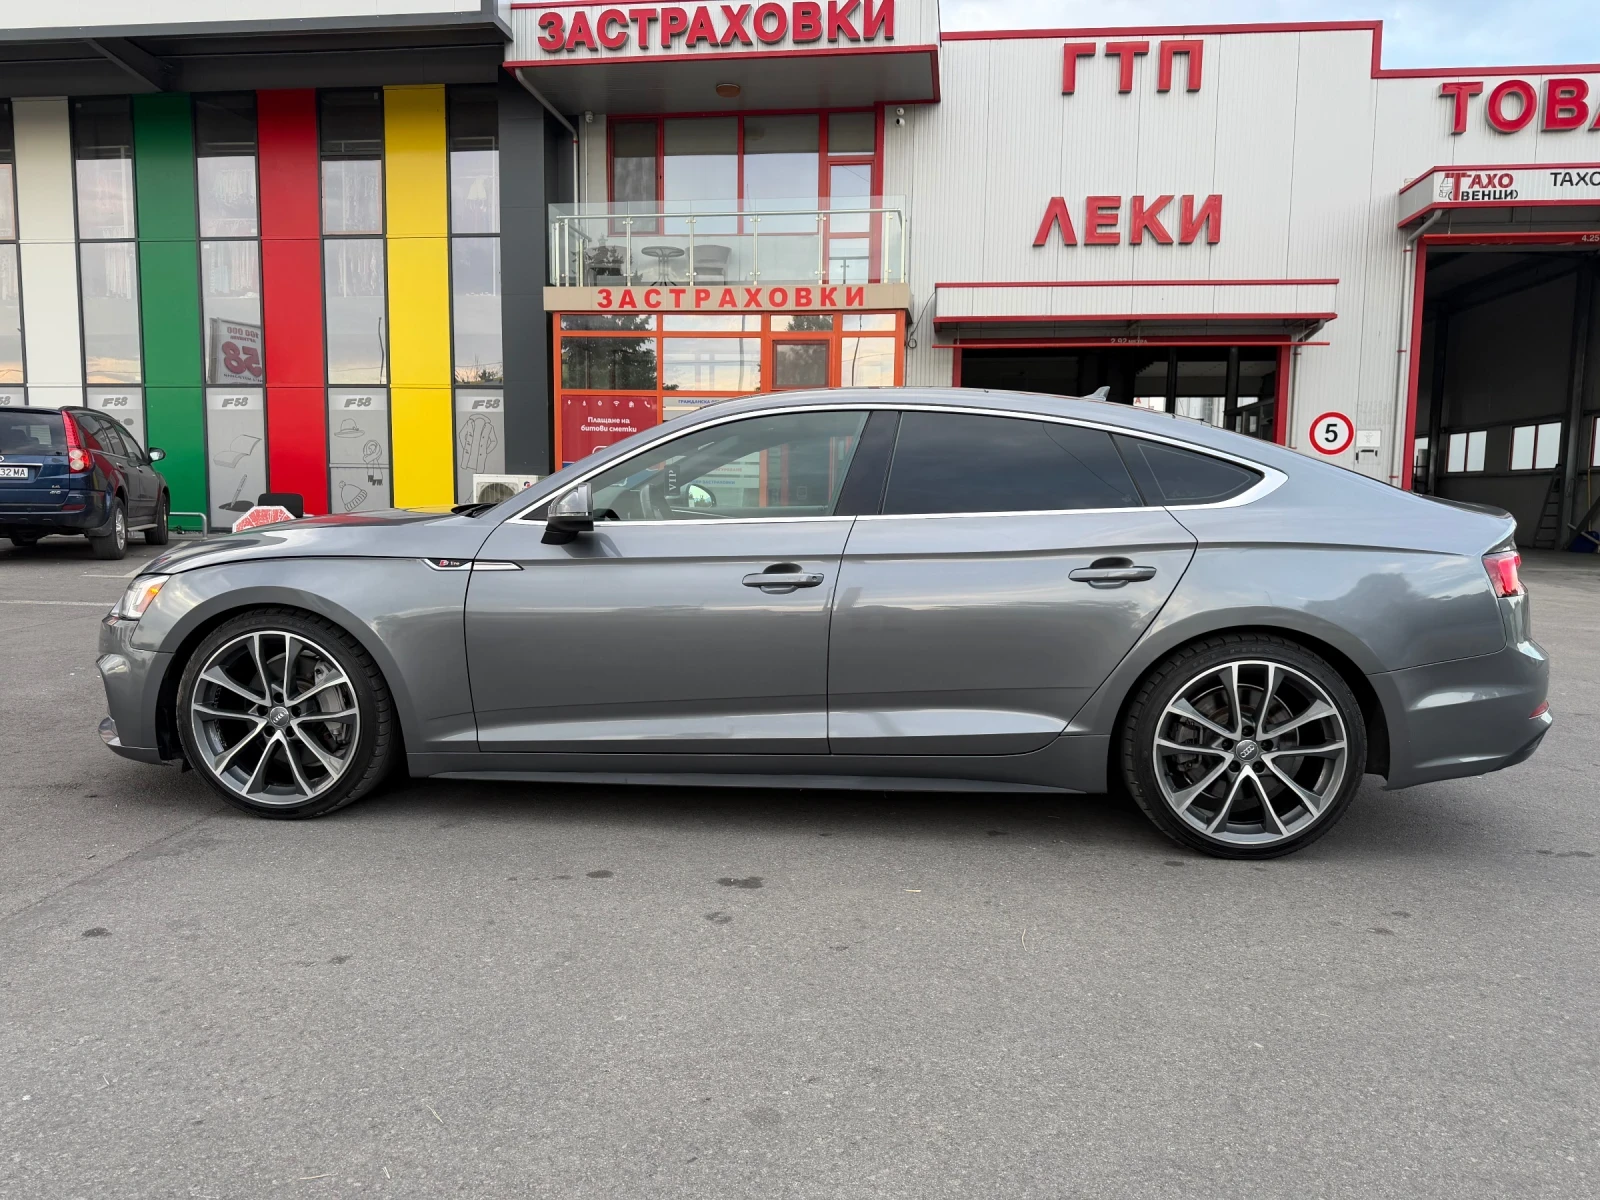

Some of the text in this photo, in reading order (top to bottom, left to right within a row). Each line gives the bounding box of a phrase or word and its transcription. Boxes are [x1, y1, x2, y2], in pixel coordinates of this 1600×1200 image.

[537, 0, 895, 52] ЗАСТРАХОВКИ
[1062, 40, 1204, 95] ГТП
[1439, 78, 1600, 135] ТОВ
[1445, 172, 1514, 200] ТАХО
[1032, 195, 1223, 247] ЛЕКИ
[1581, 234, 1600, 242] 4.25
[597, 286, 865, 309] ЗАСТРАХОВКИ
[102, 396, 128, 407] F58
[221, 397, 248, 408] F58
[343, 396, 372, 408] F58
[471, 398, 500, 410] F58
[587, 416, 621, 424] Плащане
[580, 424, 637, 433] битови сметки
[1324, 423, 1339, 443] 5
[0, 468, 26, 477] 32 MA
[668, 469, 677, 491] VIP
